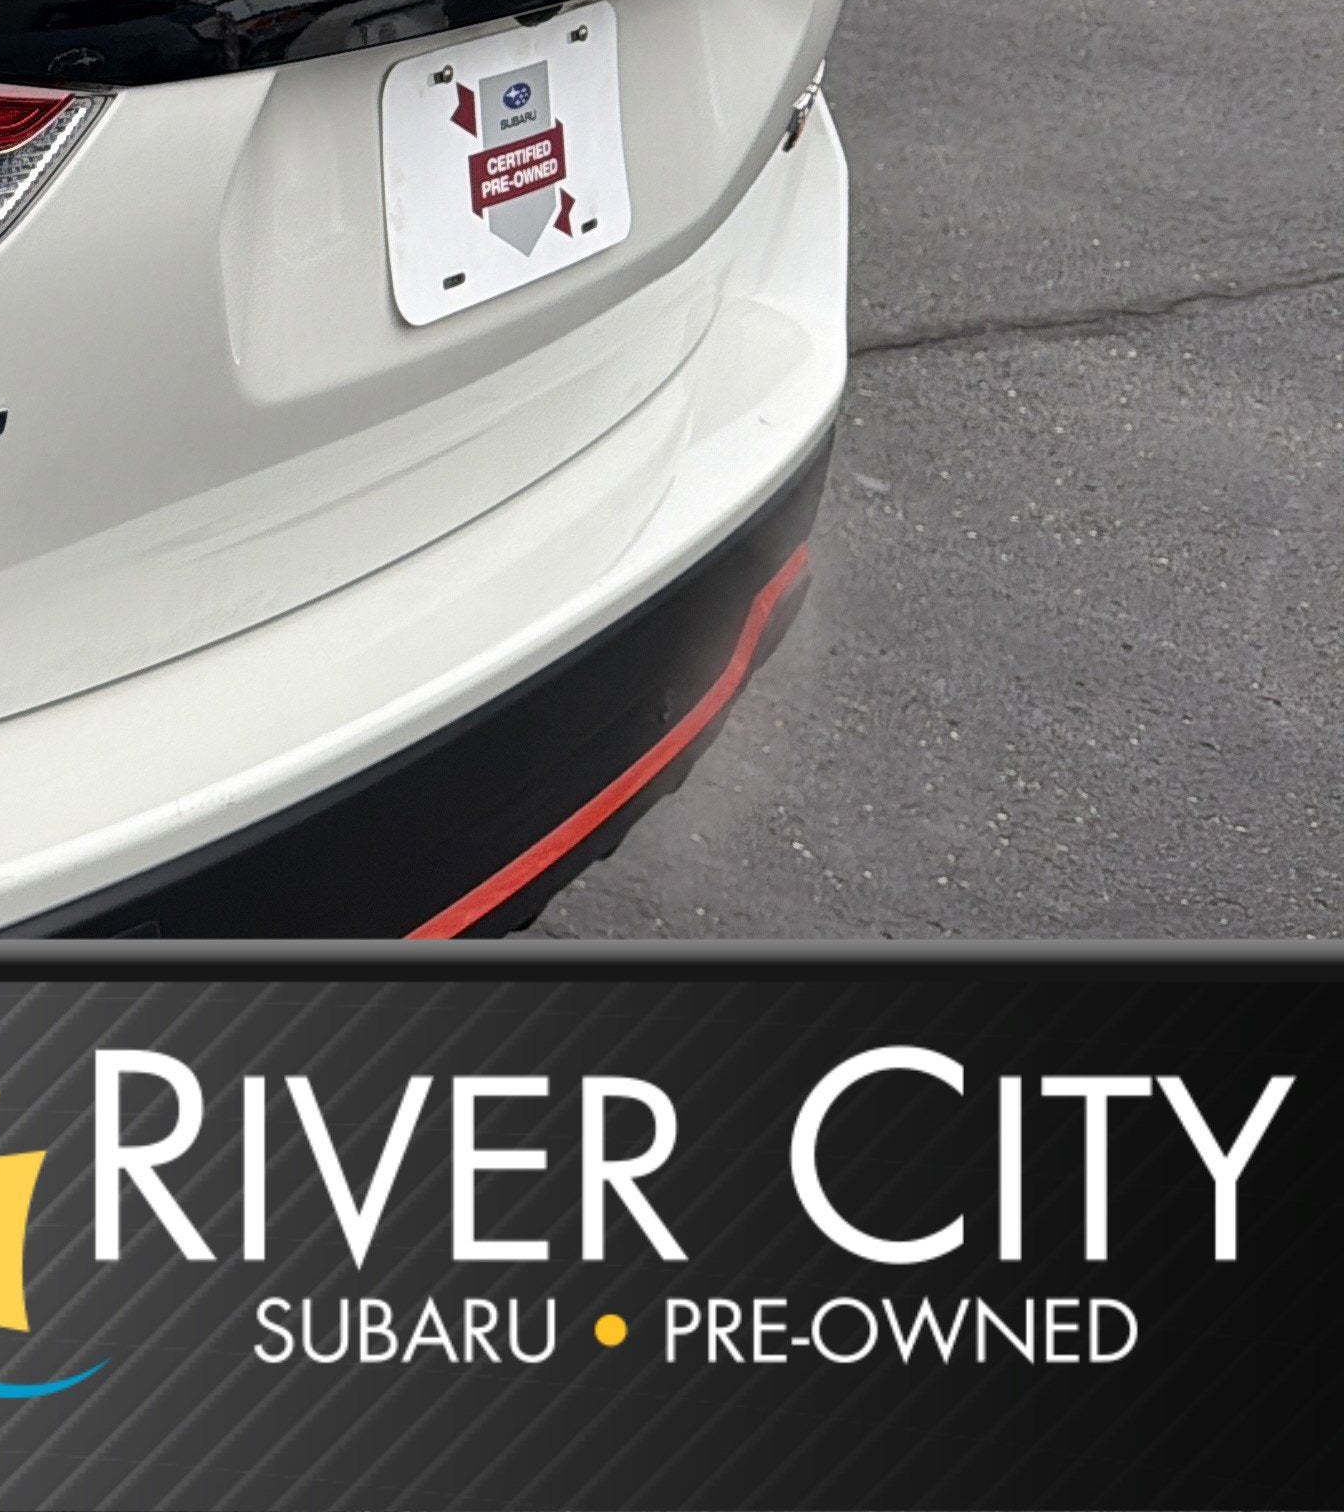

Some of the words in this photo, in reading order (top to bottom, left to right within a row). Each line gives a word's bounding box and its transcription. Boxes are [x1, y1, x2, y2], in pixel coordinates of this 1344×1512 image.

[501, 111, 537, 130] SUBARU
[486, 139, 552, 176] CERTIFIED
[481, 157, 558, 199] PRE-OWNED
